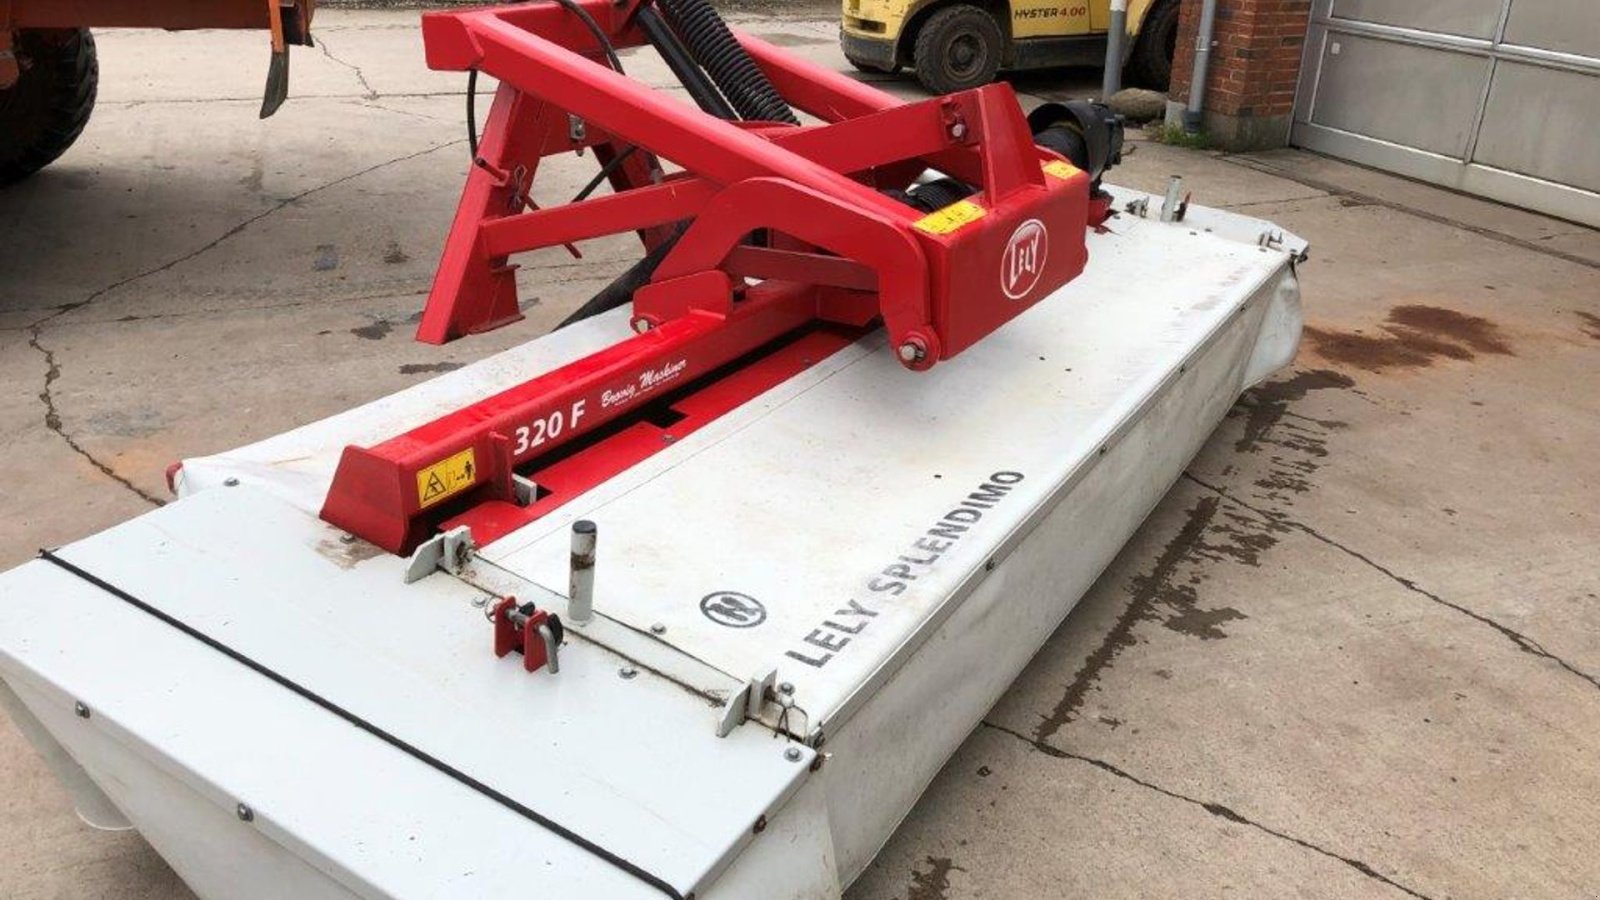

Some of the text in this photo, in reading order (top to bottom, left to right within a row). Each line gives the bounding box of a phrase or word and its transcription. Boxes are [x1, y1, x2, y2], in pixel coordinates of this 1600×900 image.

[1014, 6, 1086, 19] HYSTER 4.00
[1009, 229, 1041, 290] LELY
[640, 359, 687, 389] Maskiner
[513, 399, 586, 455] 320 F
[785, 470, 1025, 669] LELY SPLENDIMO
